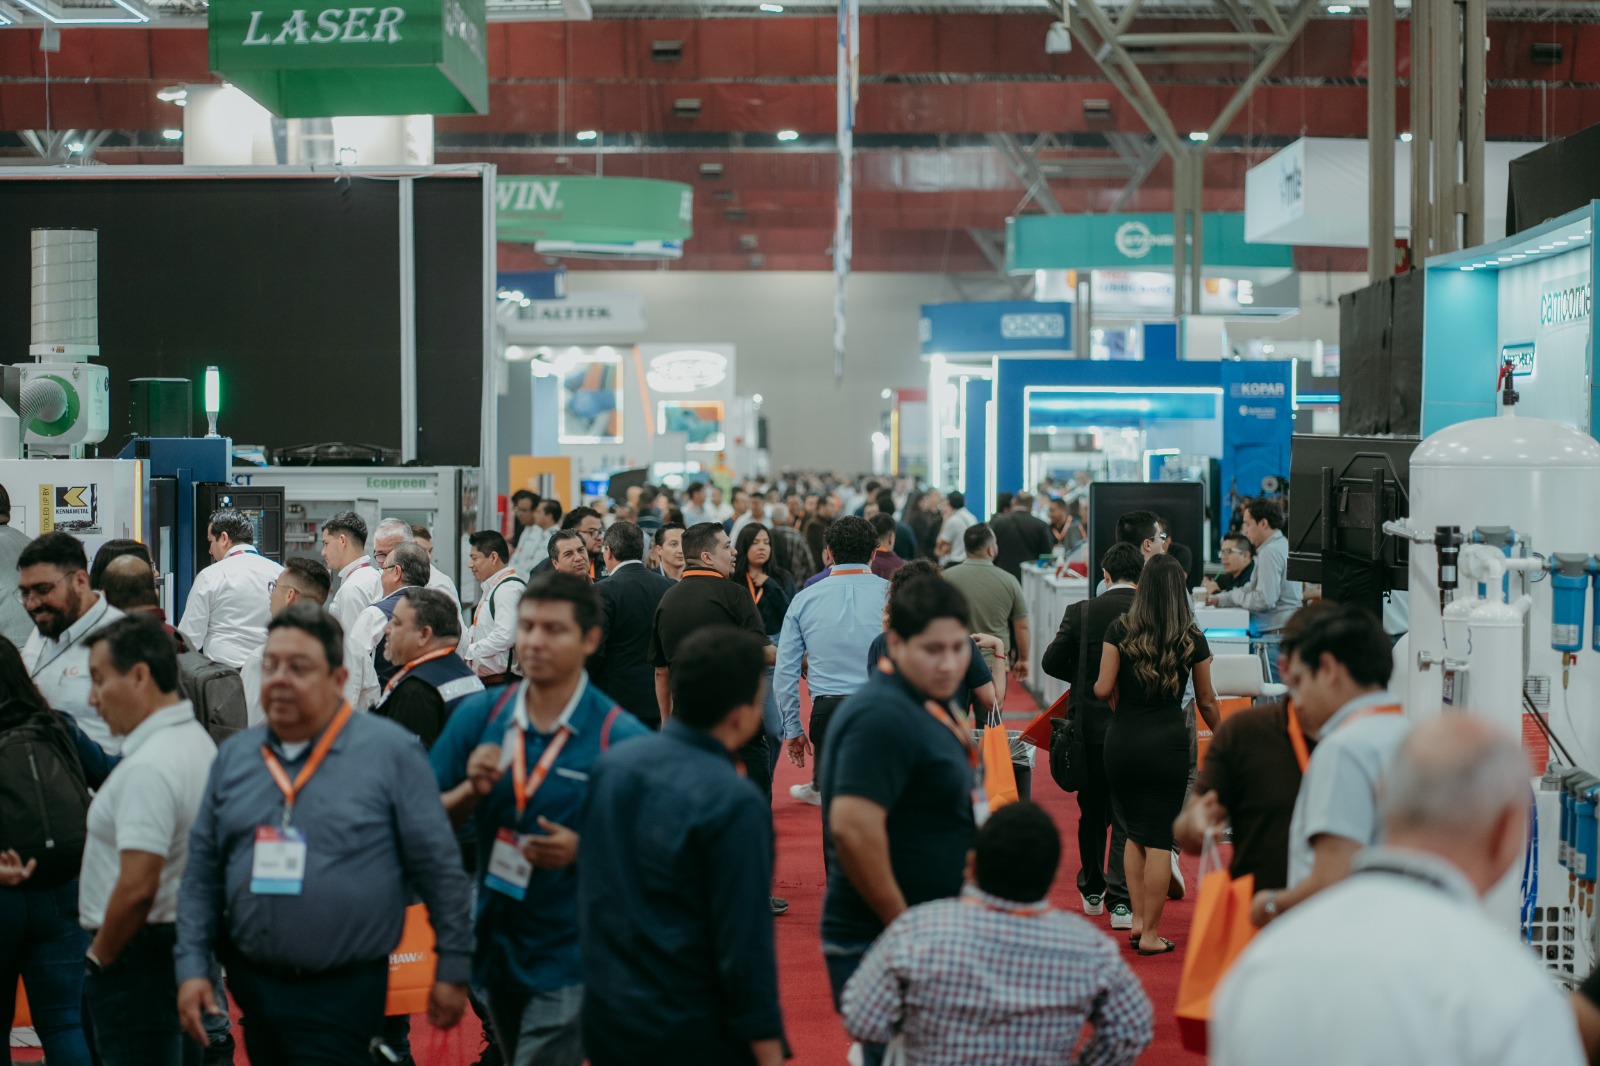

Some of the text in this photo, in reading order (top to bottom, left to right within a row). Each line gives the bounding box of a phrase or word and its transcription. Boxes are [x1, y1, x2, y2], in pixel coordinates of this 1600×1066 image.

[242, 7, 405, 45] LASER
[231, 474, 253, 486] CT
[366, 476, 427, 490] Ecogreen
[43, 487, 50, 496] BY
[43, 498, 50, 506] UP
